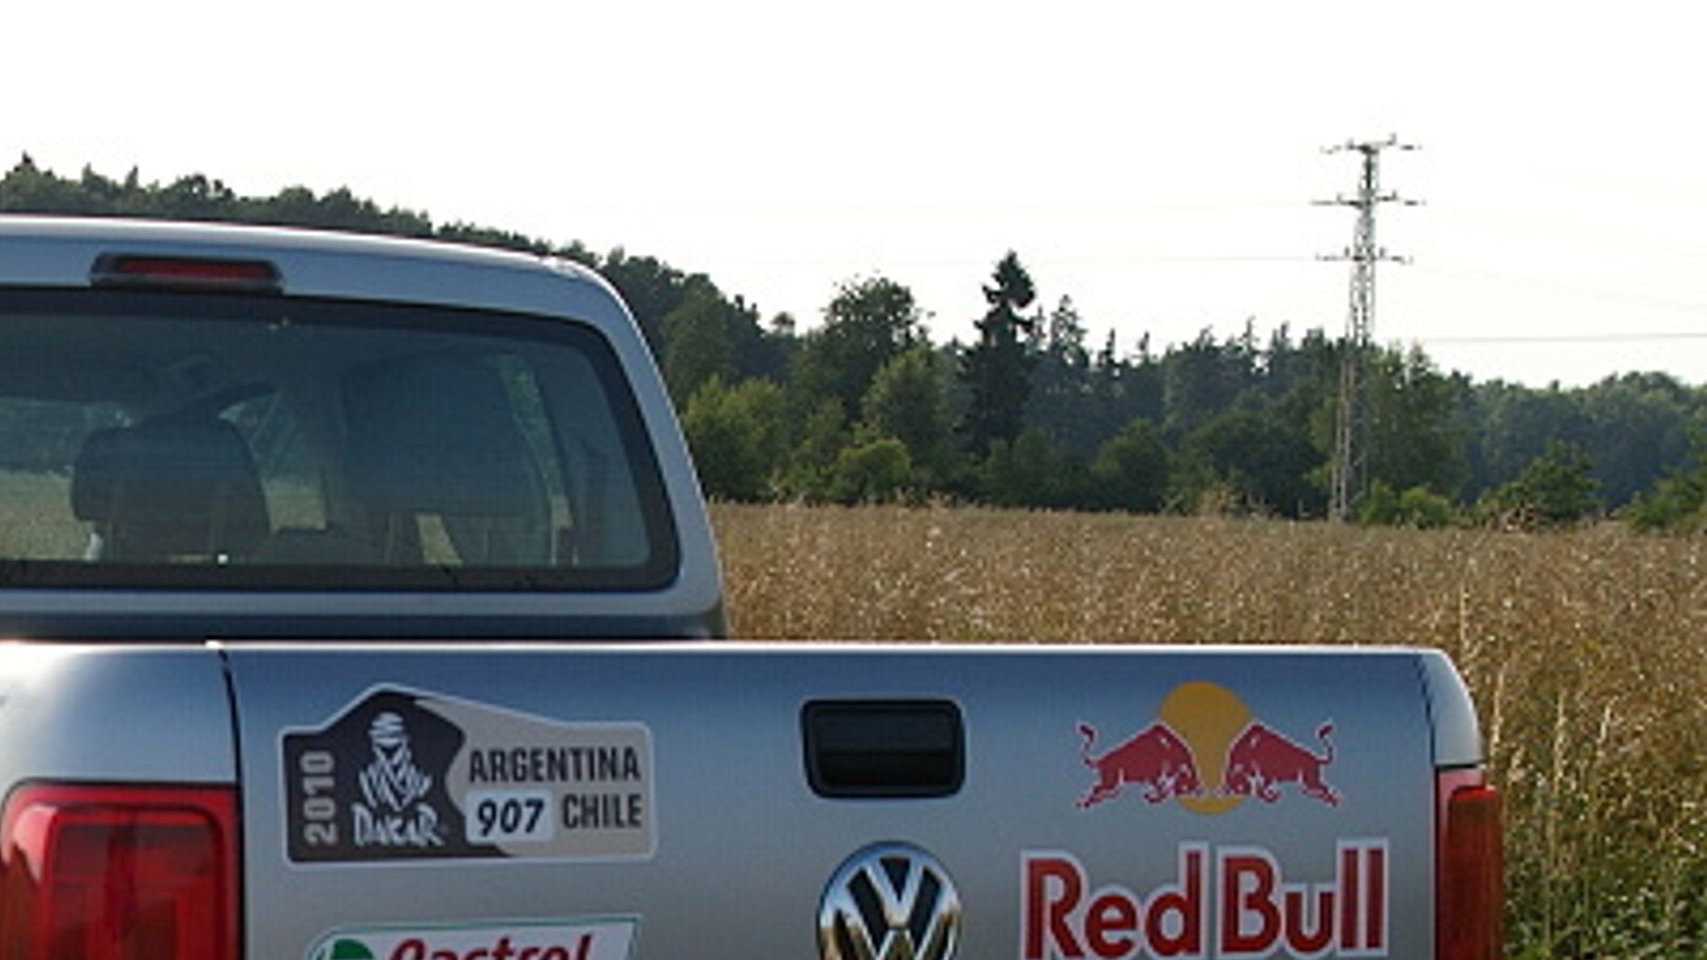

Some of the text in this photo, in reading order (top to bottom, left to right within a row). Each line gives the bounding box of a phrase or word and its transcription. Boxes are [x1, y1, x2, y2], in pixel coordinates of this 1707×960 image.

[467, 746, 641, 784] ARGENTINA
[299, 750, 338, 846] 2010
[475, 798, 546, 837] 907
[561, 793, 643, 830] CHILE
[351, 802, 445, 847] DAKAR
[1216, 837, 1389, 960] Bull
